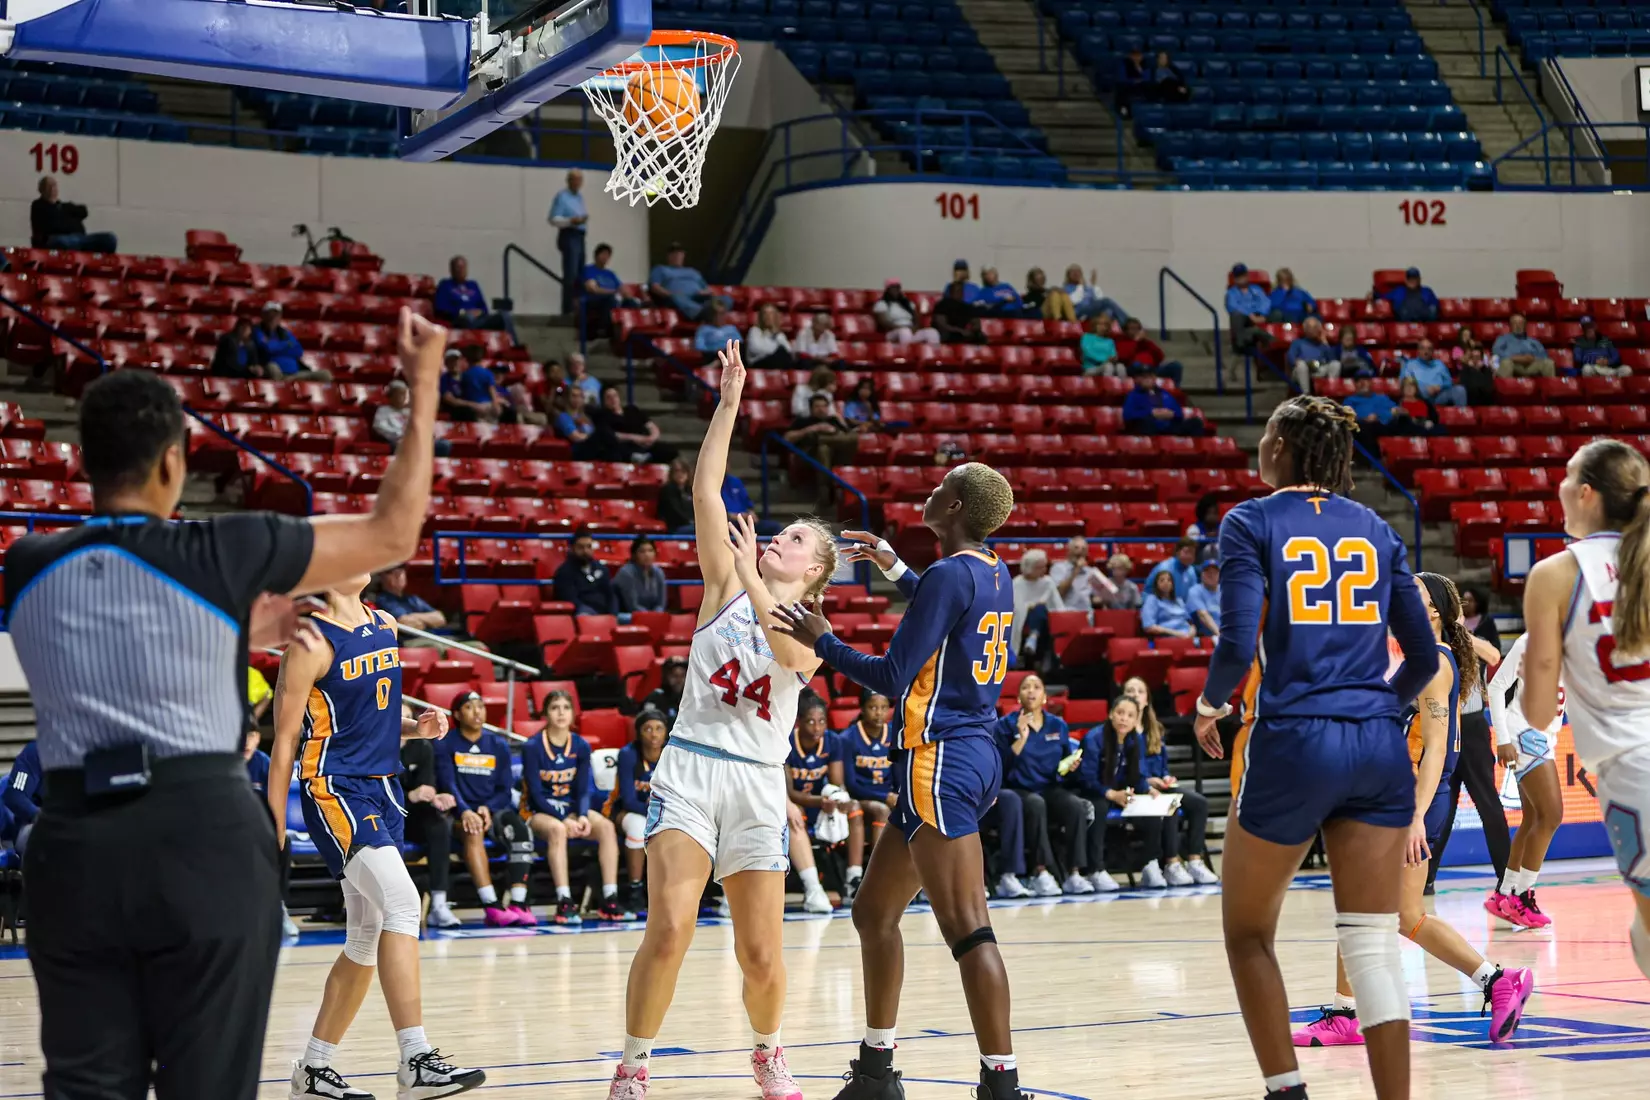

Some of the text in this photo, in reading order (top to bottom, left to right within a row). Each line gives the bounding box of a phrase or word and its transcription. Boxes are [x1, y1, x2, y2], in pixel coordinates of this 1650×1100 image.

[29, 141, 79, 174] 119
[935, 191, 980, 221] 101
[1399, 199, 1446, 226] 102
[1282, 536, 1382, 625] 22
[972, 611, 1014, 685] 35
[376, 677, 392, 711] 0
[709, 657, 772, 722] 44
